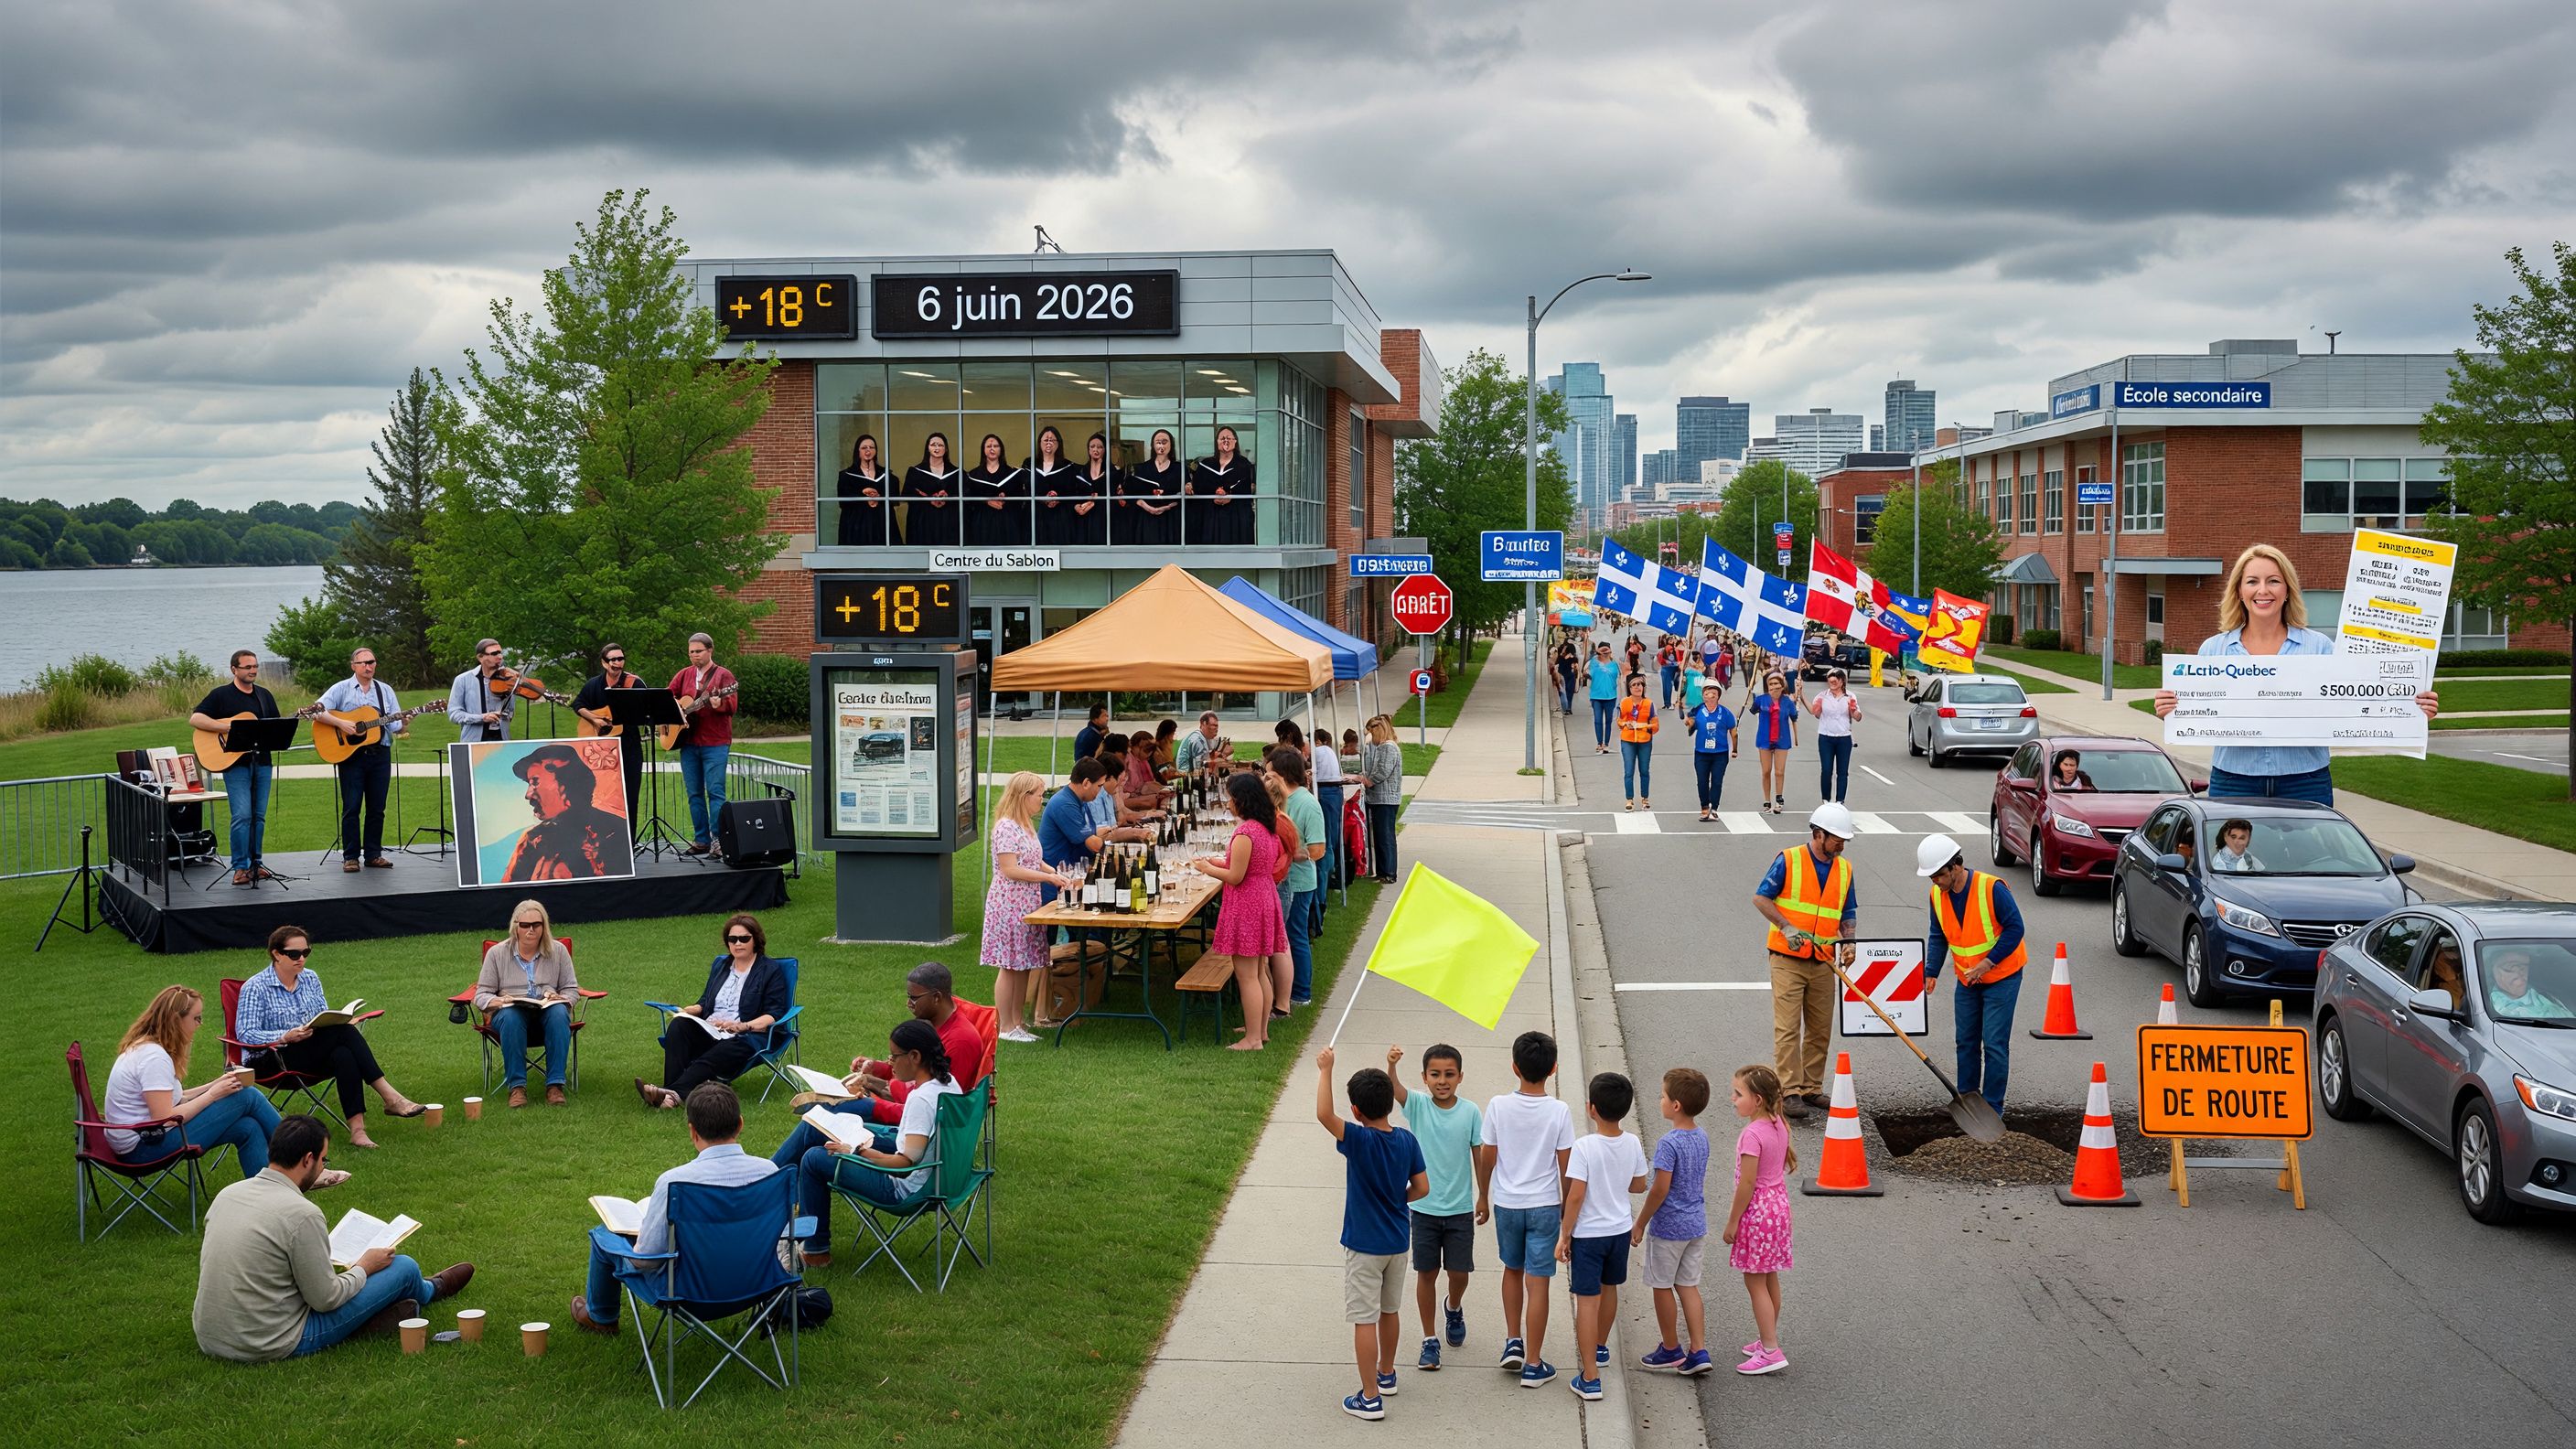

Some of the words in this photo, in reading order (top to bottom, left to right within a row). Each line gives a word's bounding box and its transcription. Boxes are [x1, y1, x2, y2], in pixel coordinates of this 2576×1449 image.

[918, 285, 941, 321] 6
[951, 285, 1021, 330] juin
[1036, 284, 1134, 320] 2026
[2123, 384, 2168, 403] École
[2173, 387, 2262, 403] secondaire
[934, 553, 982, 567] Centre
[985, 553, 1003, 567] du
[1006, 553, 1054, 567] Sablon
[2151, 1044, 2295, 1074] FERMETURE
[2163, 1088, 2195, 1117] DE
[2207, 1089, 2289, 1119] ROUTE
